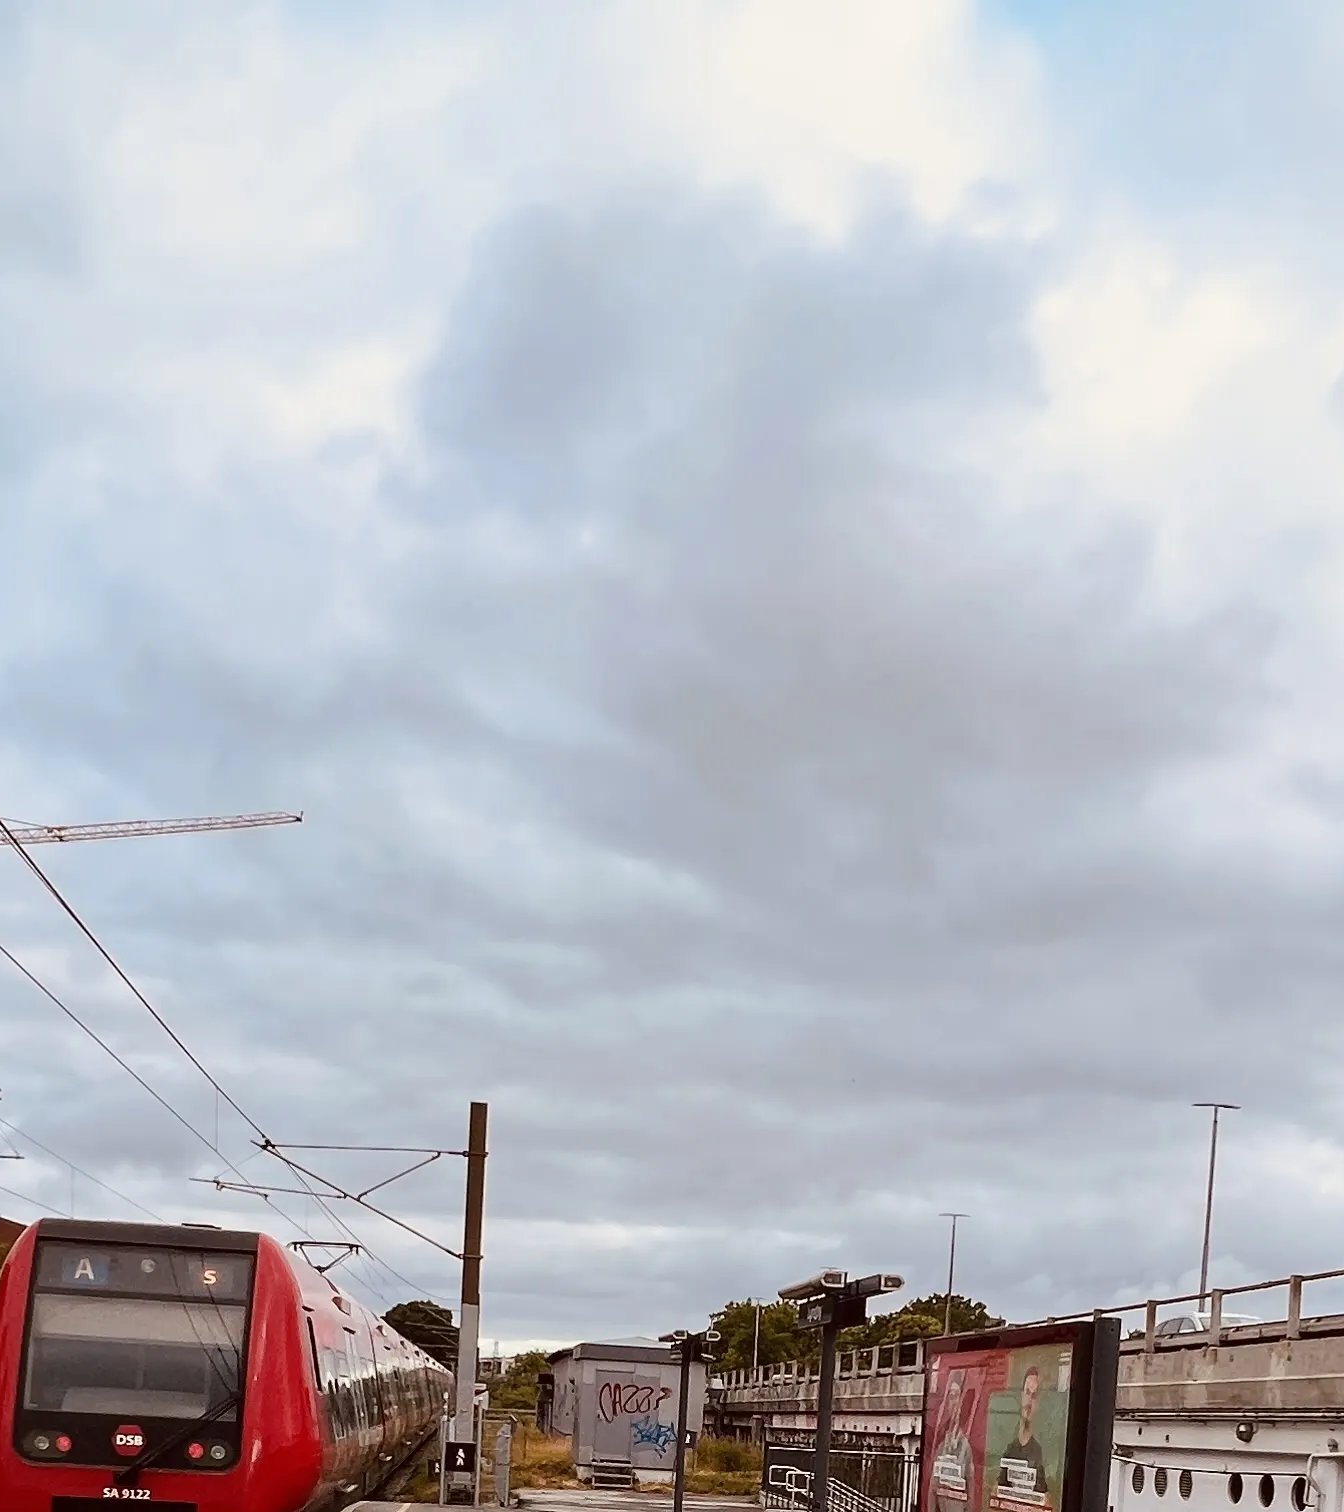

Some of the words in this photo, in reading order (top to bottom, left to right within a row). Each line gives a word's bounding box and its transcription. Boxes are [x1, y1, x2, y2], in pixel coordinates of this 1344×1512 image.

[73, 1257, 95, 1281] A
[116, 1434, 143, 1446] DSB
[102, 1487, 119, 1498] SA
[122, 1488, 151, 1500] 9122
